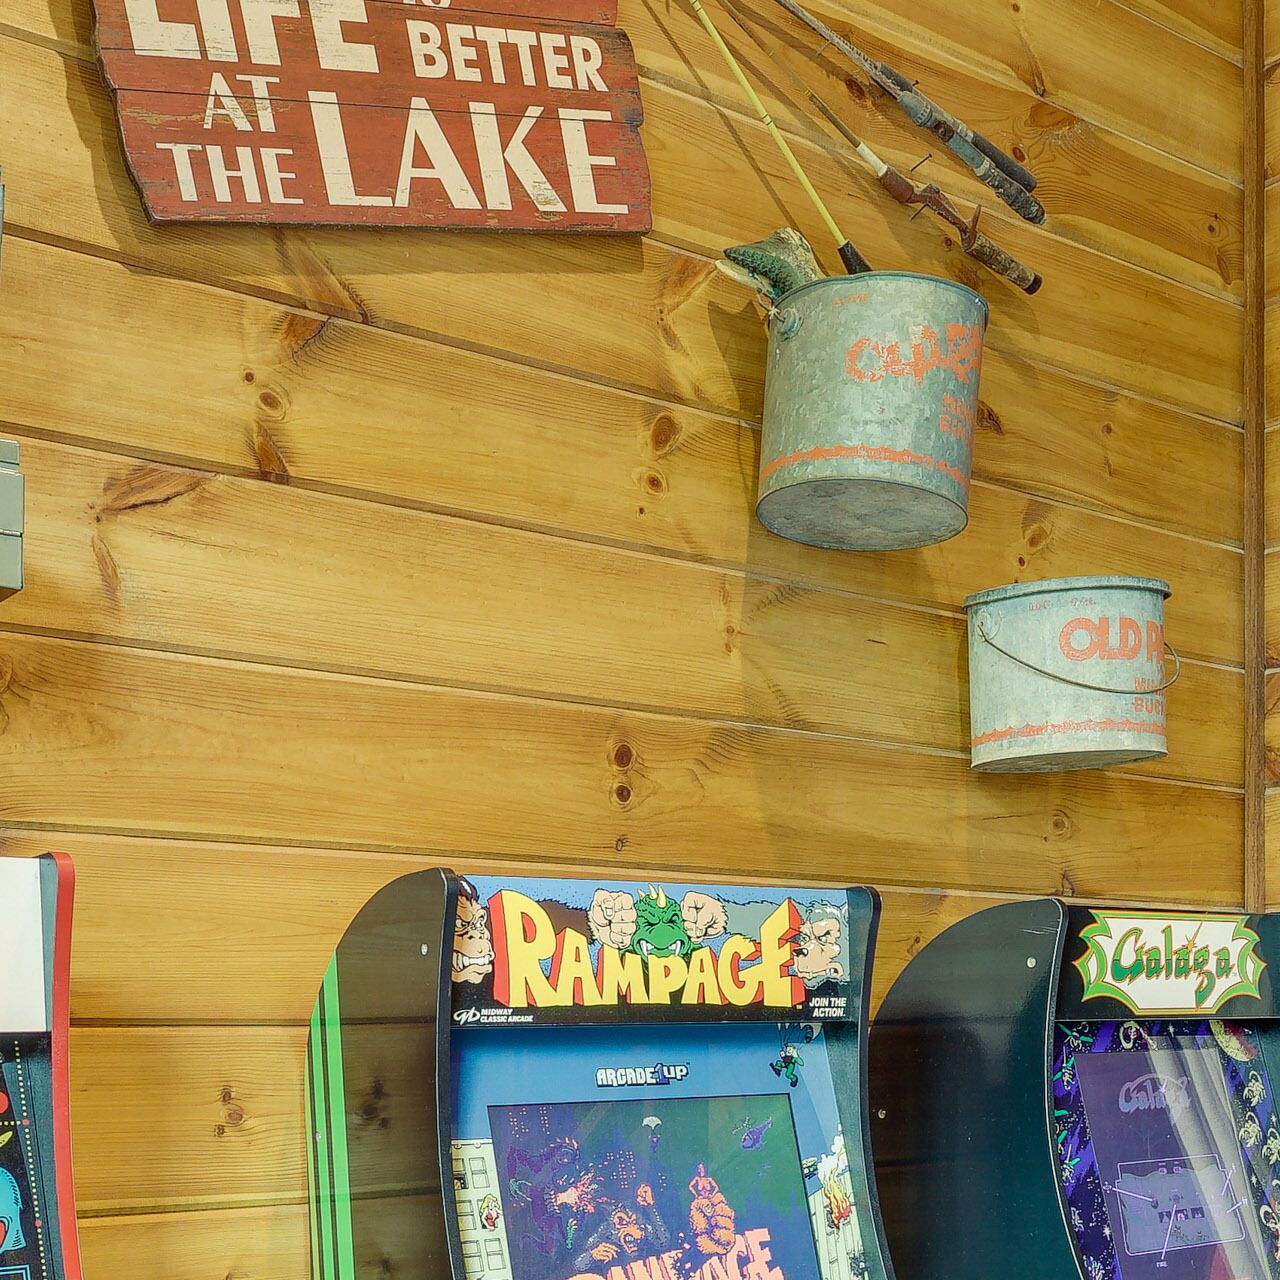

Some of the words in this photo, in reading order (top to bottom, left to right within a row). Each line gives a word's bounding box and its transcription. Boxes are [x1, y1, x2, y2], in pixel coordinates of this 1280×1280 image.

[127, 0, 379, 73] LIFE
[405, 19, 608, 92] BETTER
[203, 72, 280, 132] AT
[156, 142, 304, 204] THE
[308, 90, 628, 214] LAKE
[1059, 617, 1141, 660] OLD
[487, 889, 805, 1007] RAMPAGE
[1111, 924, 1235, 1009] Galaga
[480, 1008, 513, 1016] MIDWAY
[480, 1015, 507, 1023] CLASSIC
[508, 1014, 534, 1022] ARCADE
[809, 997, 829, 1007] JOIN
[830, 997, 847, 1007] THE
[812, 1007, 846, 1017] ACTION.
